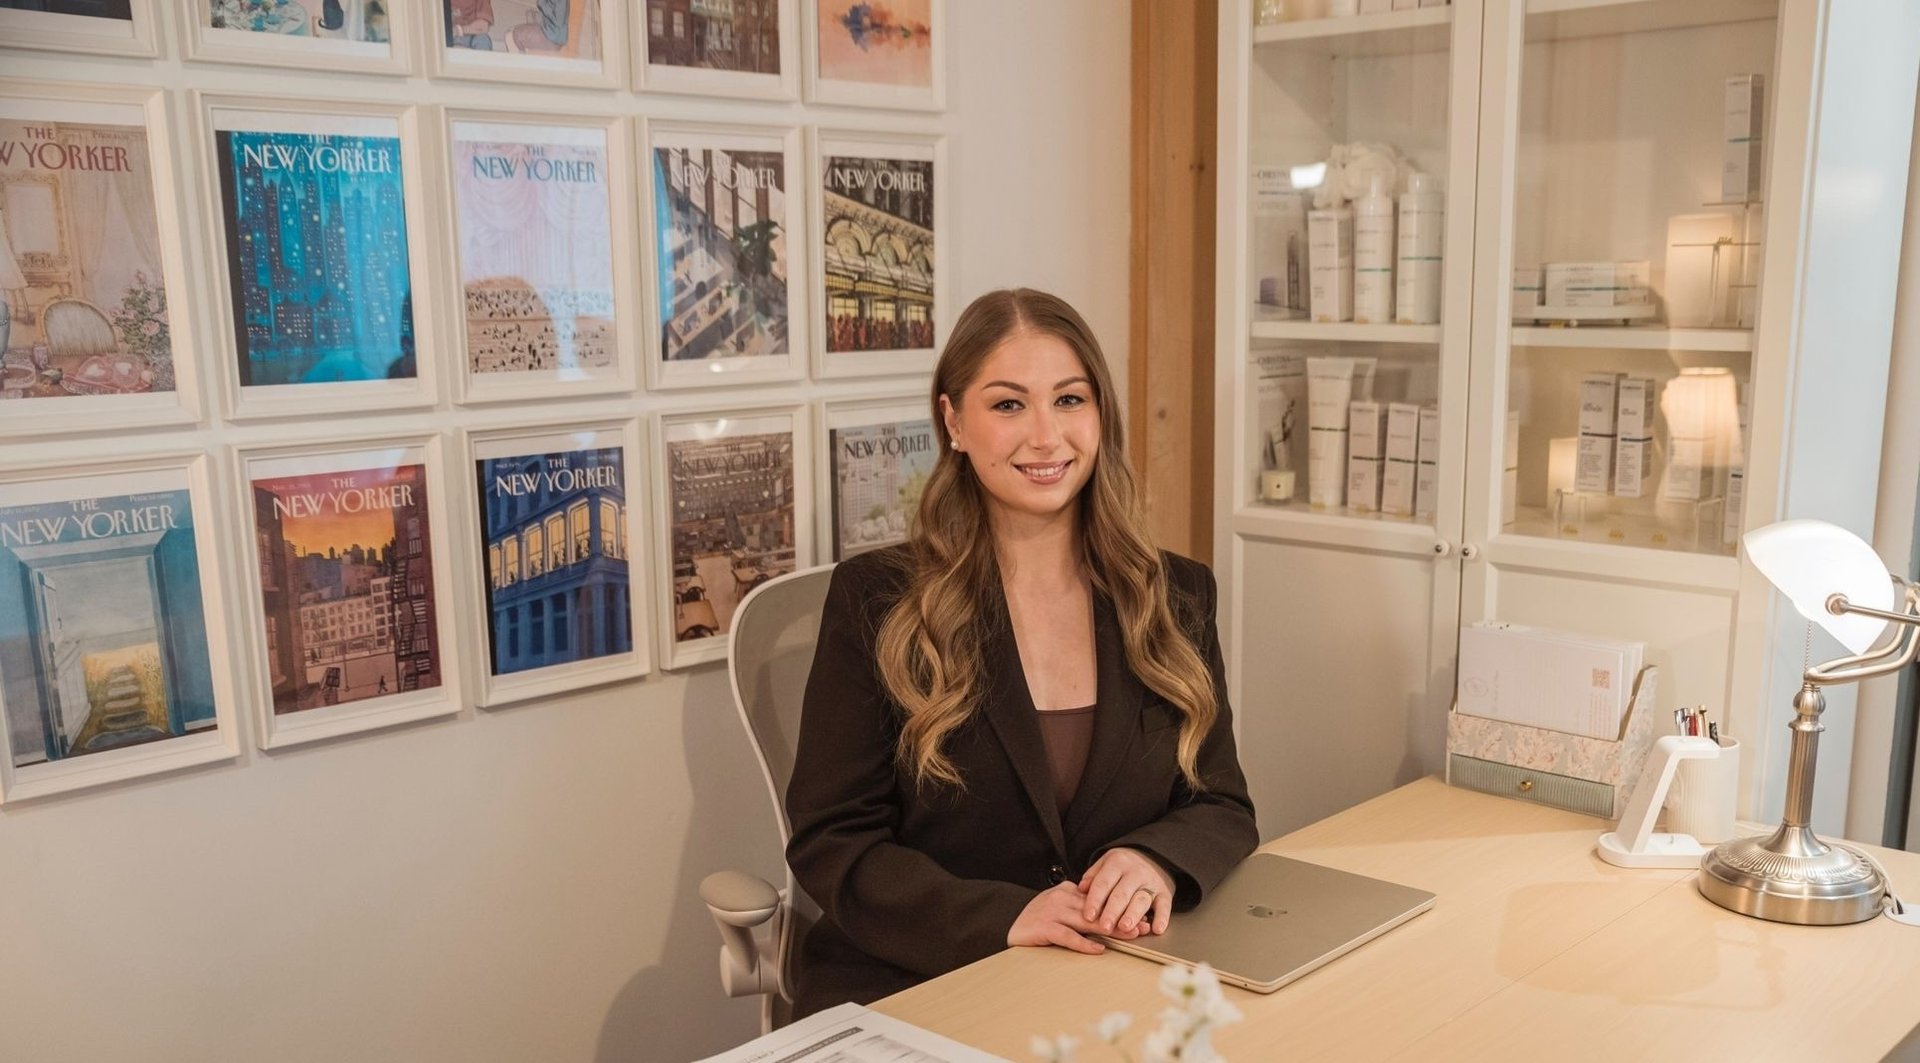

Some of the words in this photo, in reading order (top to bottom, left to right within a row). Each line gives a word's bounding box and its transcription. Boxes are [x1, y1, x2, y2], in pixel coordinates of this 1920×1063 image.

[24, 127, 55, 139] THE
[20, 142, 133, 172] YORKER
[243, 144, 298, 172] NEW
[302, 145, 392, 174] YORKER
[473, 156, 519, 179] NEW
[522, 158, 597, 183] YORKER
[835, 168, 869, 190] NEW
[870, 169, 925, 193] YORKER
[845, 440, 877, 459] NEW
[880, 433, 931, 457] YORKER
[548, 458, 570, 469] THE
[332, 478, 356, 488] THE
[496, 472, 541, 497] NEW
[544, 465, 617, 492] YORKER
[69, 500, 100, 512] THE
[273, 493, 326, 520] NEW
[328, 485, 415, 514] YORKER
[0, 517, 67, 547] NEW
[72, 505, 178, 539] YORKER
